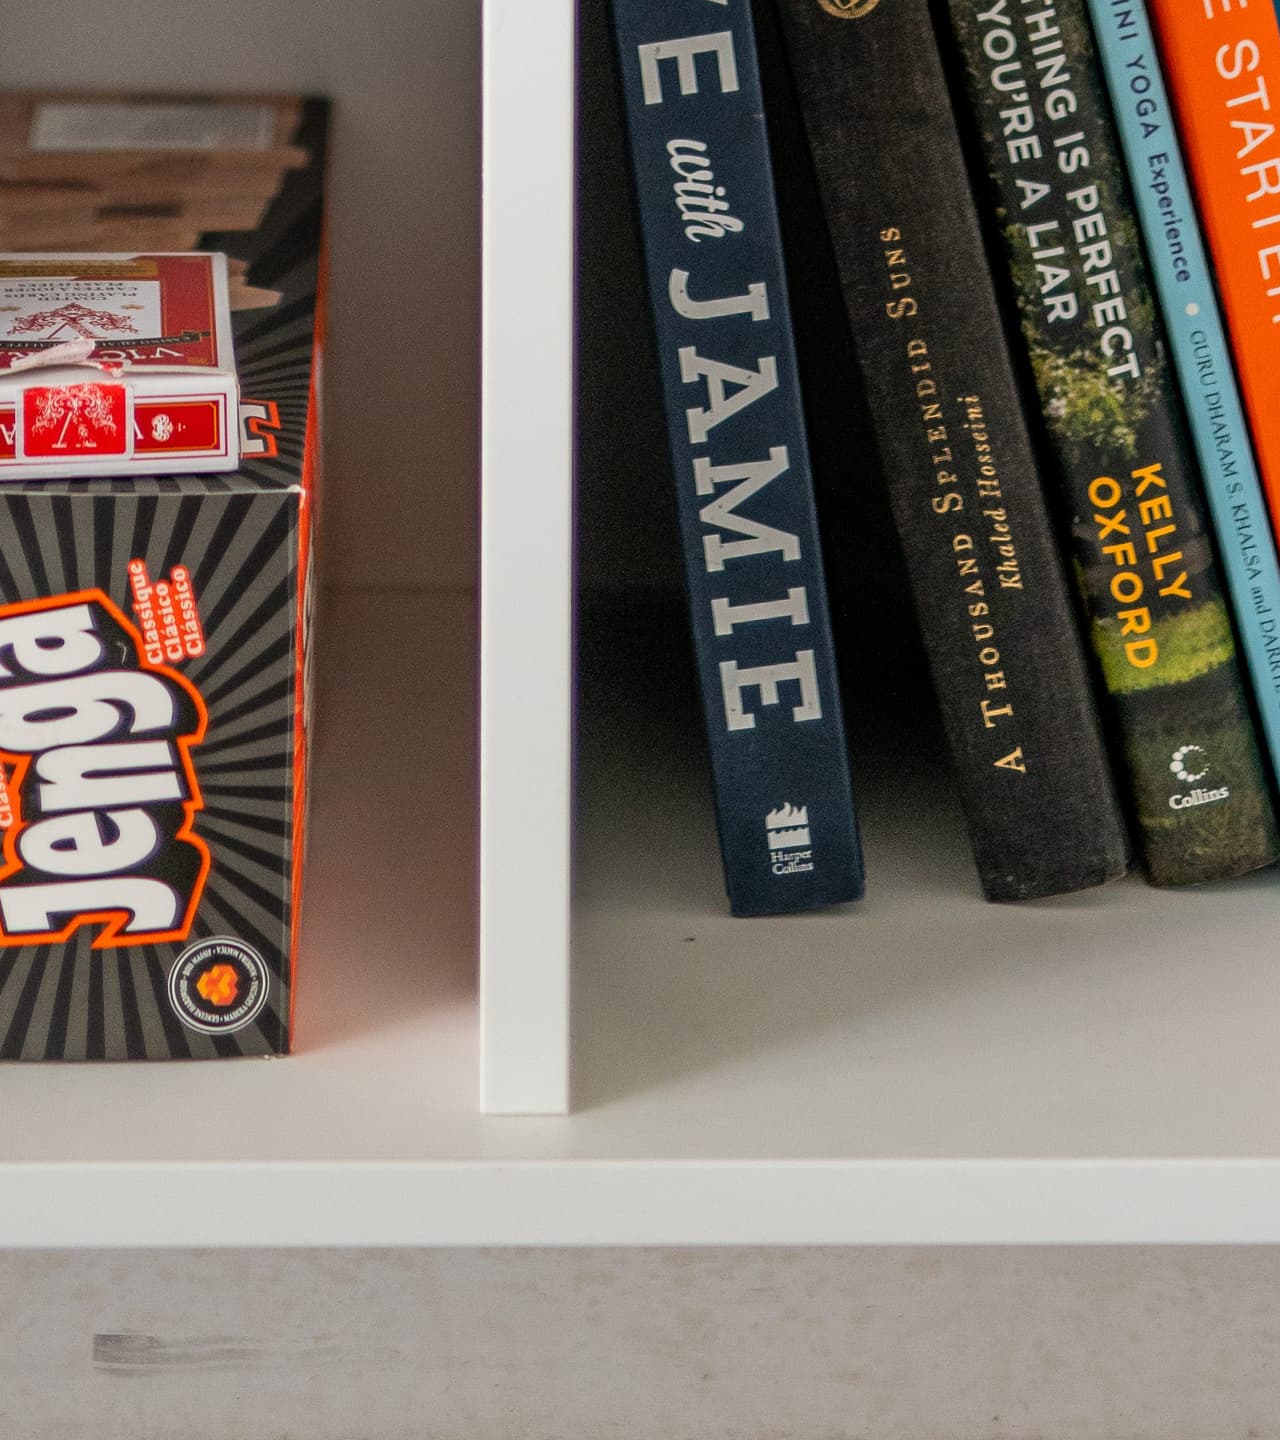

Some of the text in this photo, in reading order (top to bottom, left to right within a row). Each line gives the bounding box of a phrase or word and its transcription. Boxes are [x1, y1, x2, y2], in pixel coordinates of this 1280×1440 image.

[666, 138, 744, 243] with
[1016, 179, 1052, 209] A
[1055, 131, 1089, 174] IS
[1124, 53, 1157, 139] YOGA
[1148, 154, 1191, 283] Experience
[1025, 221, 1078, 325] LIAR
[1066, 185, 1141, 379] PERFECT
[668, 268, 822, 731] JAMIE
[880, 228, 1026, 773] A THOUSAND SPLENDID SUNS
[1131, 464, 1191, 600] KELLY
[129, 561, 163, 664] Classique
[156, 583, 183, 660] Clásico
[173, 567, 203, 655] Clássico
[1088, 477, 1157, 668] OXFORD
